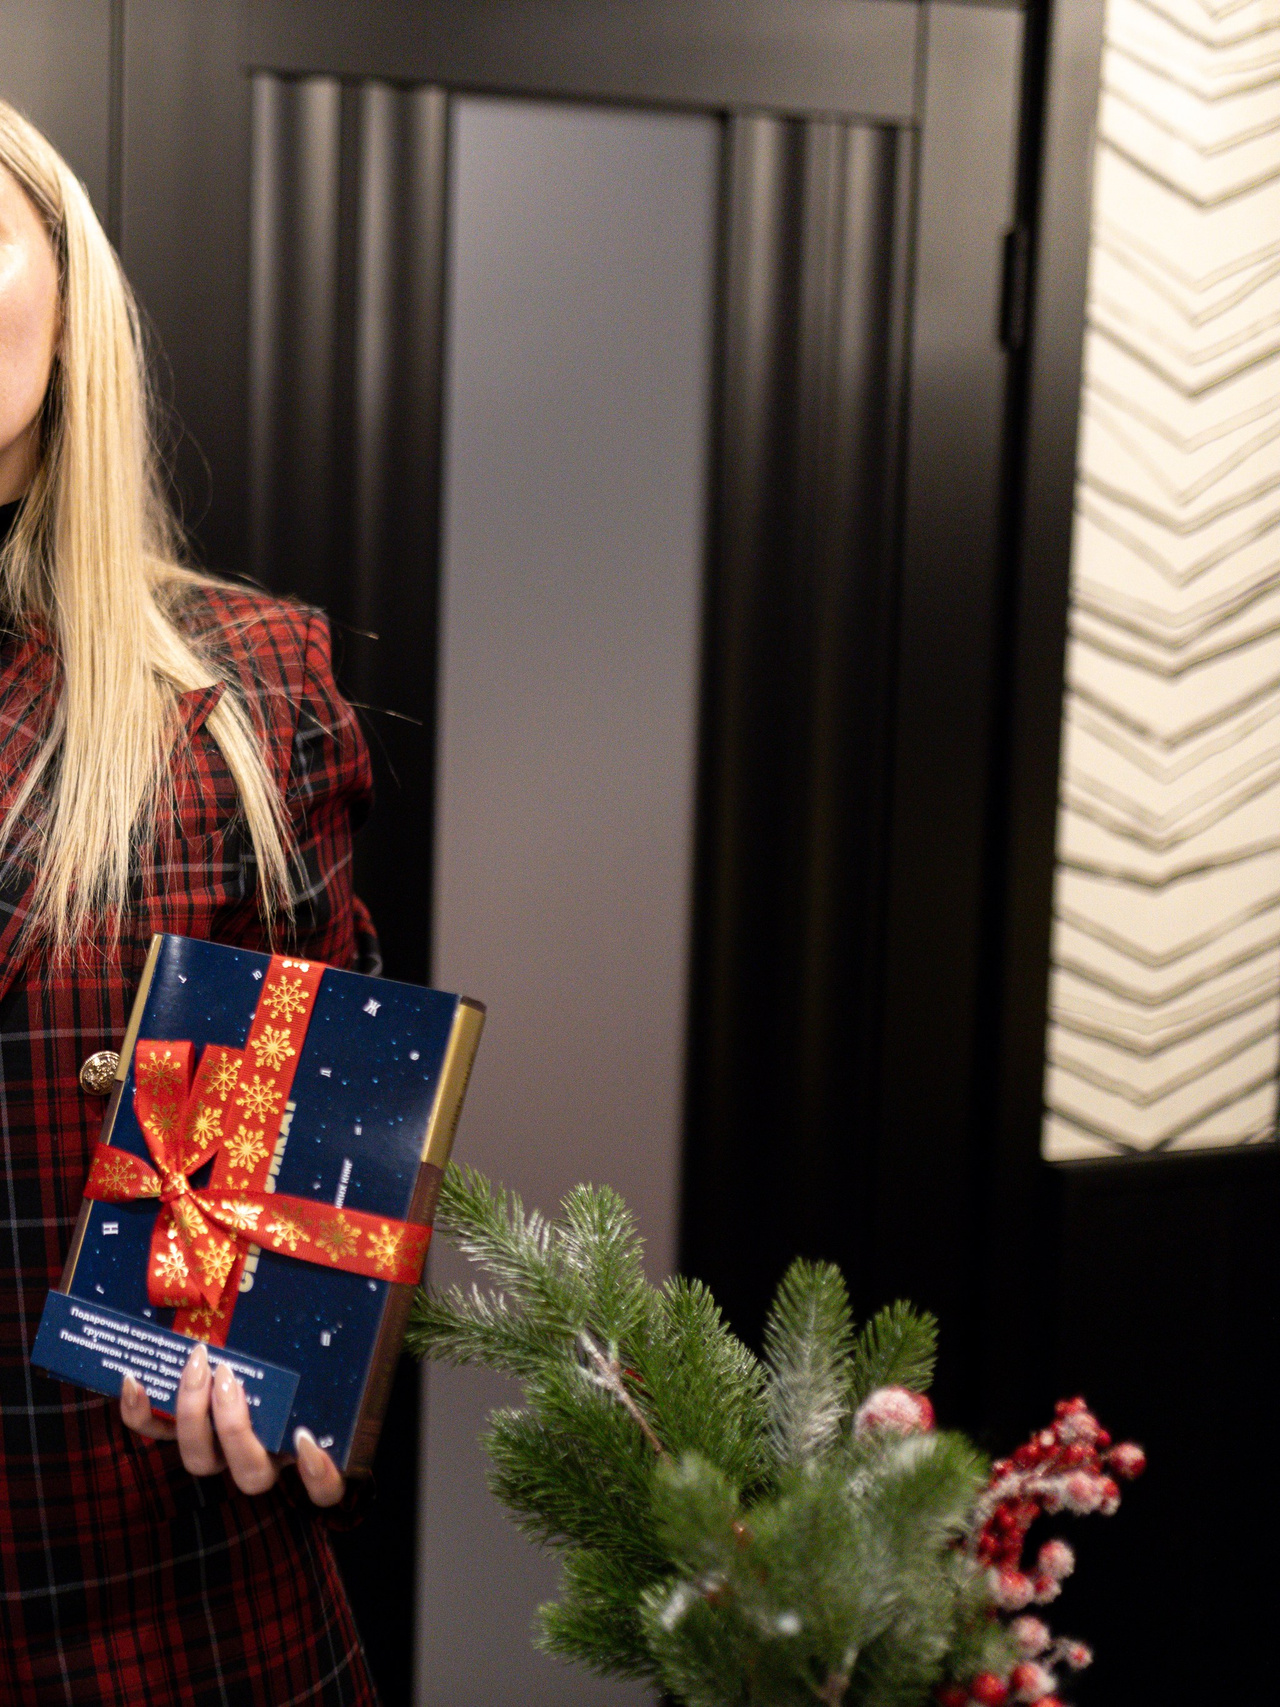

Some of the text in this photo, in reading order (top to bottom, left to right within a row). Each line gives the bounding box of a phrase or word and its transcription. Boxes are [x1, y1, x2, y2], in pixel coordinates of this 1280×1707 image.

[71, 1307, 130, 1333] Подарочный
[131, 1329, 186, 1353] сертификат
[83, 1326, 115, 1342] группе
[117, 1337, 154, 1356] первого
[155, 1352, 177, 1365] года
[60, 1331, 122, 1358] Помощником
[130, 1356, 157, 1371] книга
[159, 1364, 182, 1379] Эрик
[143, 1374, 177, 1391] играют
